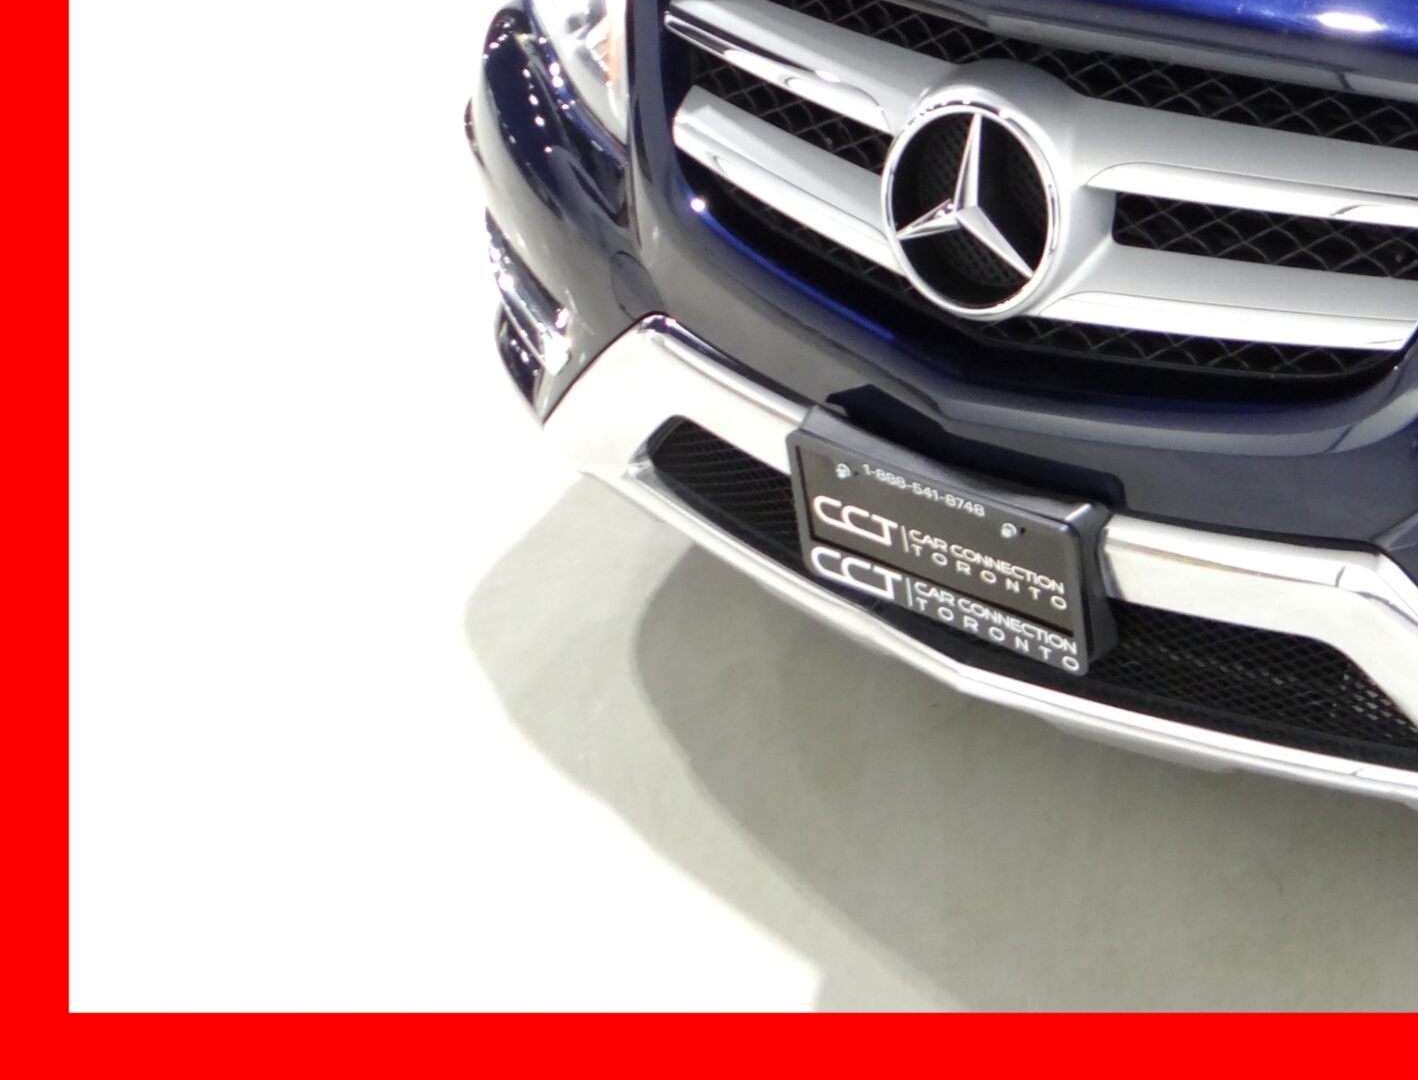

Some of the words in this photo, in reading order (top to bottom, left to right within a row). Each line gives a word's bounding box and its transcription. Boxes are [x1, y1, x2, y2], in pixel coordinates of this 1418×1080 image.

[862, 463, 985, 517] 1-888-541-8748
[908, 529, 949, 552] CAR
[950, 544, 1065, 594] CONNECTION
[911, 543, 1068, 610] TORONTO
[914, 581, 956, 607] CAR
[957, 597, 1077, 654] CONNECTION
[915, 596, 1080, 671] TORONTO
